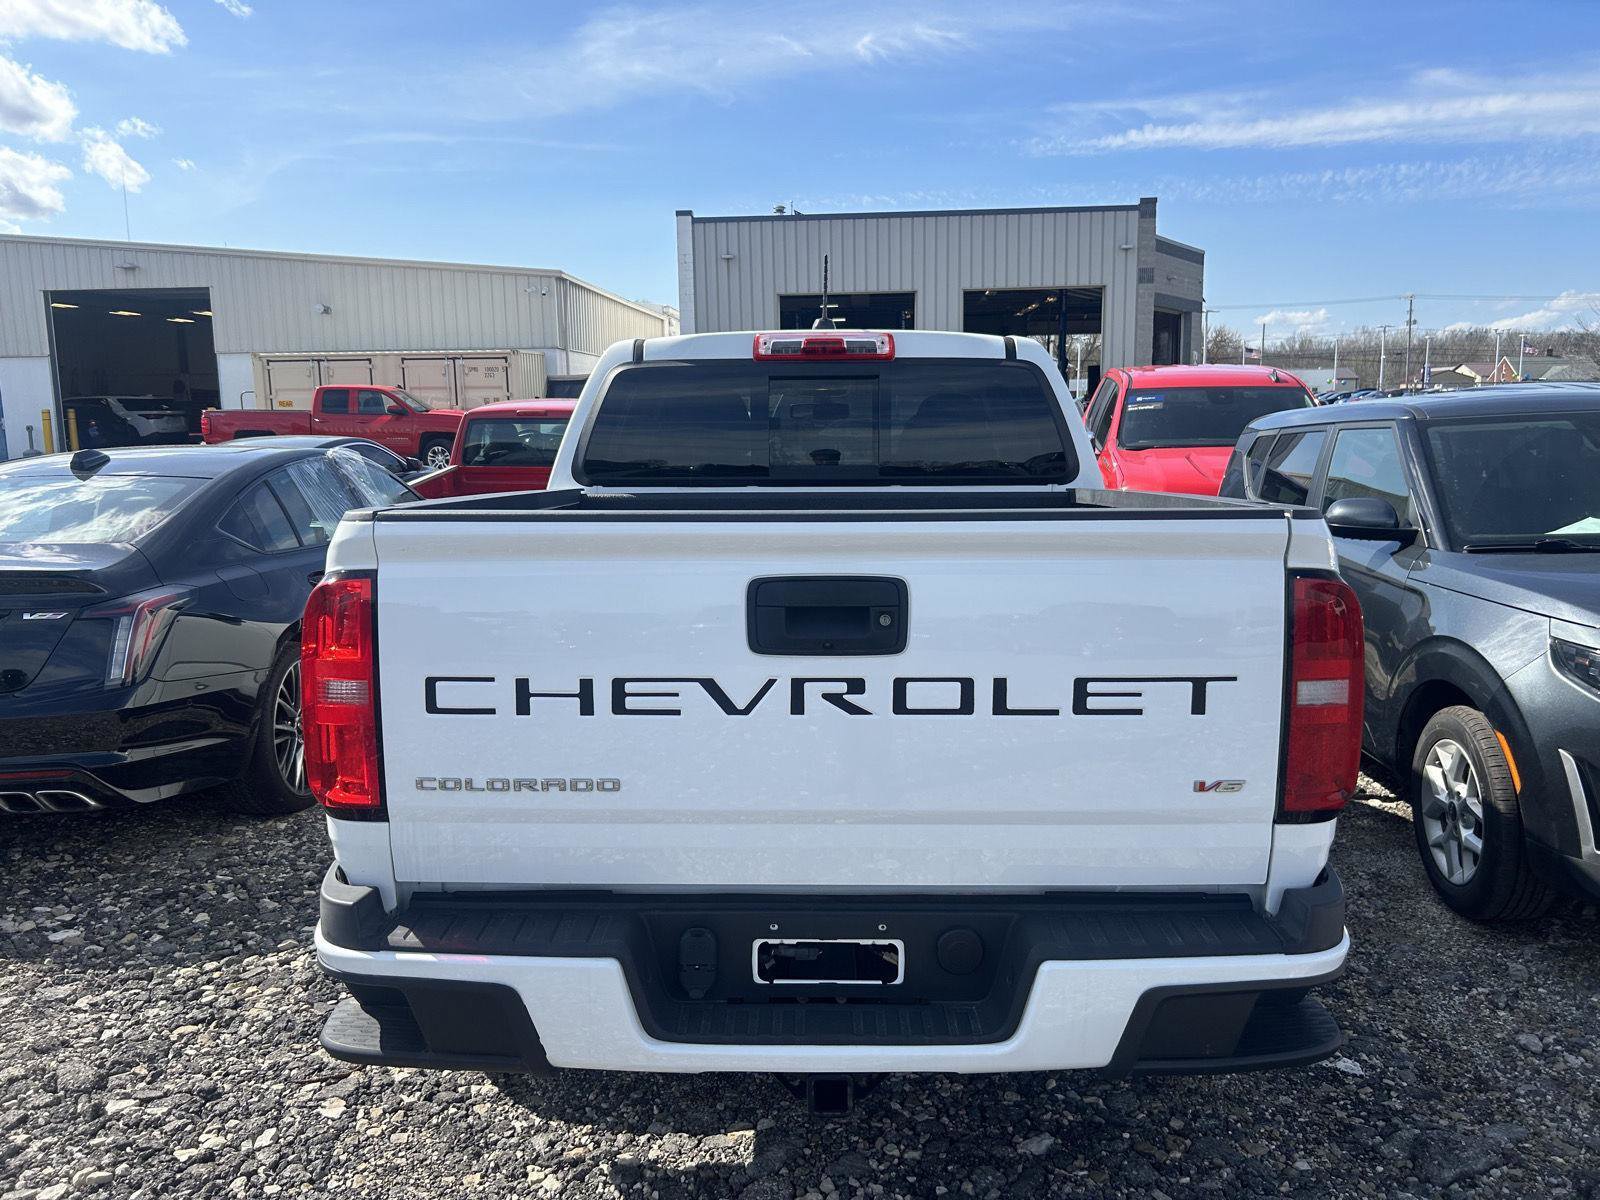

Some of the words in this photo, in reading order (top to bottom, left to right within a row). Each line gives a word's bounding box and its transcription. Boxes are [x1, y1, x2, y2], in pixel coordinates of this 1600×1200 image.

[278, 400, 293, 408] REAR
[424, 676, 1237, 715] CHEVROLET
[415, 777, 621, 792] COLORADO
[1193, 779, 1247, 793] V6
